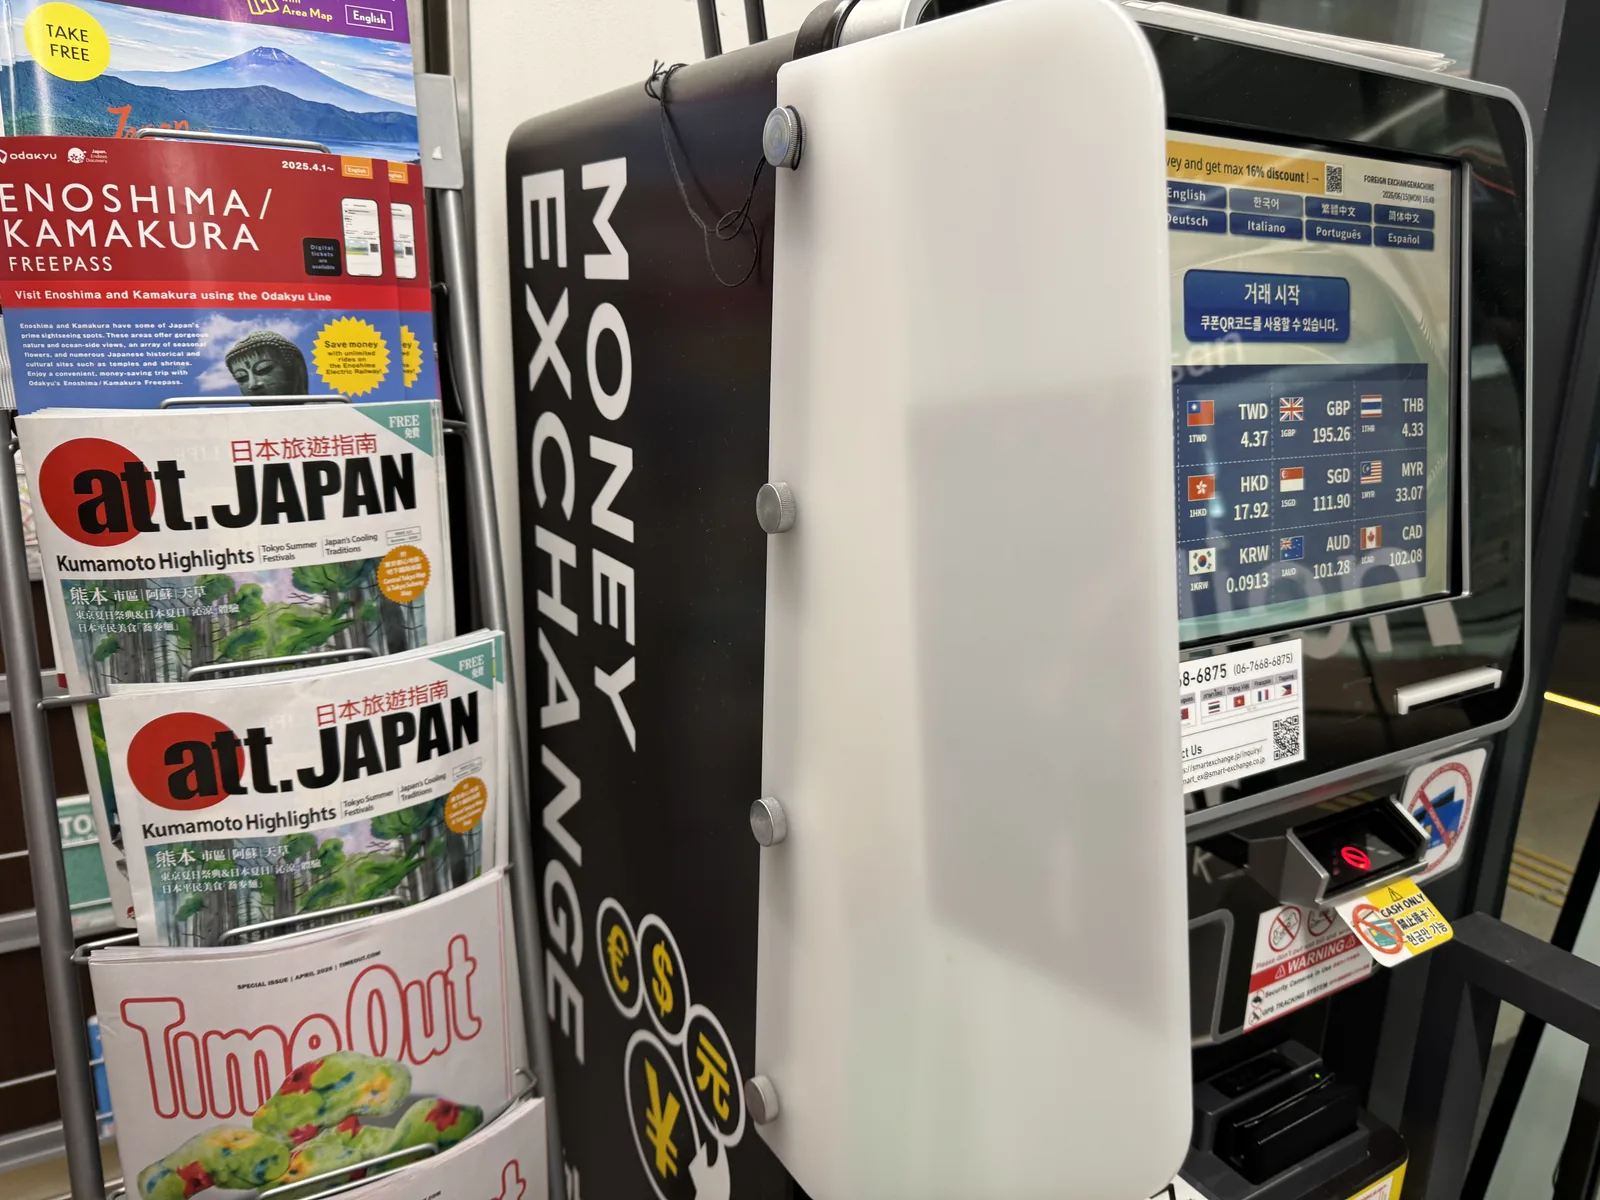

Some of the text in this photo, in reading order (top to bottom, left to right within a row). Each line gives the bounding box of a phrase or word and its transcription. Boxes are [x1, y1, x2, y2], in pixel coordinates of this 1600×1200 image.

[282, 5, 333, 22] Area Map
[353, 10, 387, 25] English
[46, 24, 89, 43] TAKE
[50, 43, 90, 62] FREE
[9, 151, 57, 160] odakyu
[281, 161, 334, 172] 2025.4.1~
[1184, 158, 1305, 183] and get max 16% discount
[1363, 175, 1387, 185] FOREIGN
[0, 182, 250, 218] ENOSHIMA
[1167, 187, 1206, 202] English
[1253, 196, 1280, 210] 한국어
[1321, 203, 1356, 218] 繁體中文
[1167, 213, 1209, 227] Deutsch
[1247, 220, 1286, 233] Italiano
[3, 219, 260, 251] KAMAKURA
[1315, 226, 1362, 241] Português
[1388, 233, 1420, 245] Español
[8, 256, 113, 272] FREEPASS
[15, 290, 332, 302] Visit Enoshima and Kamakura using the Odakyu Line
[1244, 283, 1300, 306] 거래 시작
[168, 322, 200, 330] Japan's
[1200, 315, 1339, 332] 쿠폰QR코드를 사용할 수 있습니다.
[324, 340, 378, 349] Save money
[1238, 403, 1268, 421] TWD
[1326, 400, 1351, 416] GBP
[1402, 397, 1424, 413] THB
[388, 414, 420, 428] FREE
[1401, 422, 1424, 437] 4.33
[404, 426, 420, 439] 免費
[1240, 430, 1269, 448] 4.37
[1312, 426, 1351, 444] 195.26
[230, 433, 377, 464] 日本旅遊指南
[581, 157, 637, 753] MONEY
[1326, 468, 1351, 485] SGD
[1401, 461, 1424, 477] MYR
[1241, 475, 1268, 492] HKD
[73, 453, 417, 534] att.JAPAN
[1395, 486, 1423, 502] 33.07
[1233, 502, 1269, 521] 17.92
[1312, 495, 1351, 512] 111.90
[324, 536, 351, 547] Japan's
[351, 533, 378, 543] Cooling
[1402, 525, 1423, 541] CAD
[262, 541, 317, 553] Tokyo Summer
[325, 545, 362, 556] Traditions
[1326, 534, 1350, 552] AUD
[56, 548, 255, 573] Kumamoto Highlights
[262, 553, 296, 563] Festivals
[1239, 545, 1269, 565] KRW
[1389, 548, 1423, 567] 102.08
[1313, 560, 1350, 579] 101.28
[1226, 572, 1269, 594] 0.0913
[69, 585, 206, 605] 熊本 市區 阿蘇 天草
[521, 168, 585, 1066] EXCHANGE
[458, 653, 485, 671] FREE
[1233, 652, 1293, 676] (06-7668-6875)
[316, 679, 449, 727] 日本旅遊指南
[164, 691, 479, 801] att.JAPAN
[1190, 744, 1203, 756] Us
[400, 772, 447, 793] Japan's Cooling
[342, 789, 394, 808] Tokyo Summer
[401, 787, 433, 801] Traditions
[344, 804, 374, 817] Festivals
[142, 807, 337, 840] Kumamoto Highlights
[155, 847, 196, 869] 熊本
[1380, 893, 1426, 918] CASH ONLY
[1405, 921, 1448, 946] 현금만 가능
[1287, 939, 1345, 974] WARNING
[237, 950, 381, 990] SPECIAL ISSUE APRIL 2026 TIMEOUT.COM
[1265, 984, 1288, 998] Security
[1289, 972, 1314, 988] Cameras
[1321, 965, 1332, 973] Use
[1262, 982, 1328, 1016] GPS TRACKING SYSTEM
